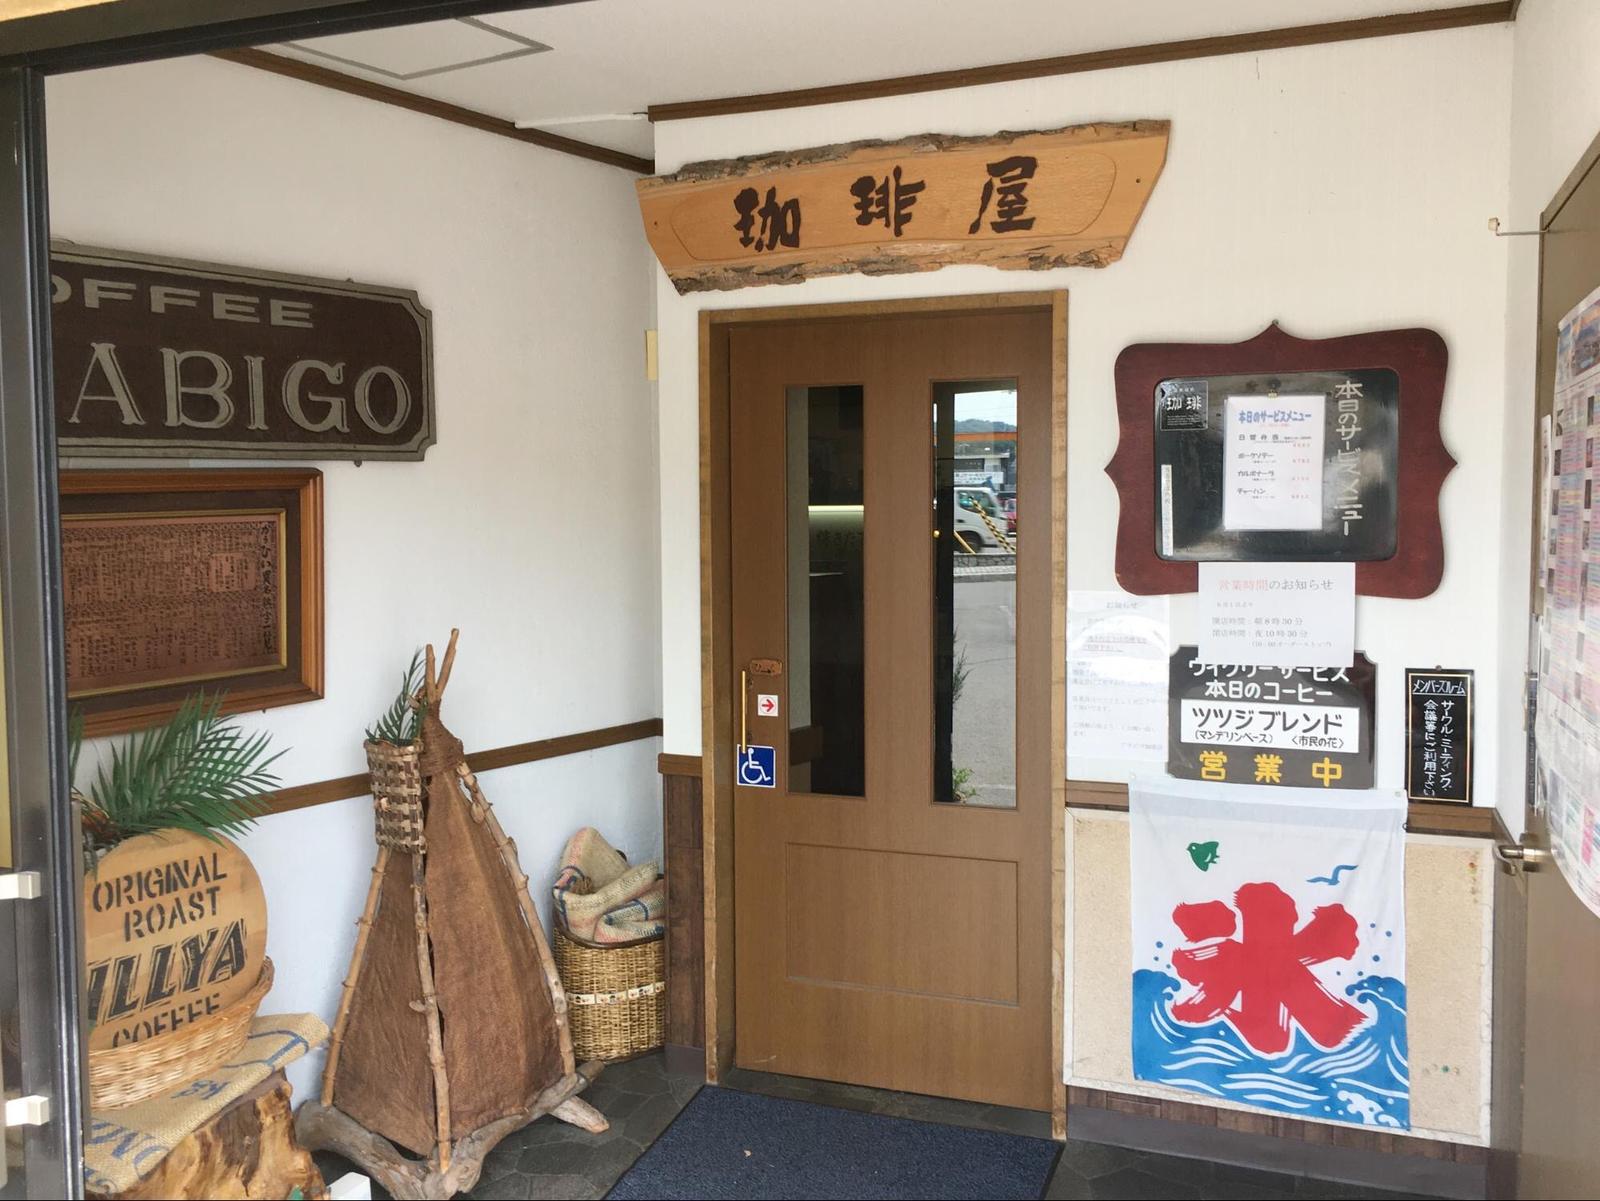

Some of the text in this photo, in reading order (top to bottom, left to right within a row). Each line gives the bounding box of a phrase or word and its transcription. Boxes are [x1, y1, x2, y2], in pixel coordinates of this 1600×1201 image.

[733, 156, 1037, 252] 珈琲屋
[68, 342, 411, 434] ABIGO
[1238, 410, 1312, 423] 本日のサービスメニュー
[1205, 679, 1333, 702] 本日のコーヒー
[1192, 707, 1343, 735] ツツジブレンド
[1199, 750, 1343, 787] 営業中
[92, 852, 228, 913] ORIGINAL
[123, 885, 221, 942] ROAST
[1170, 881, 1369, 1055] 氷
